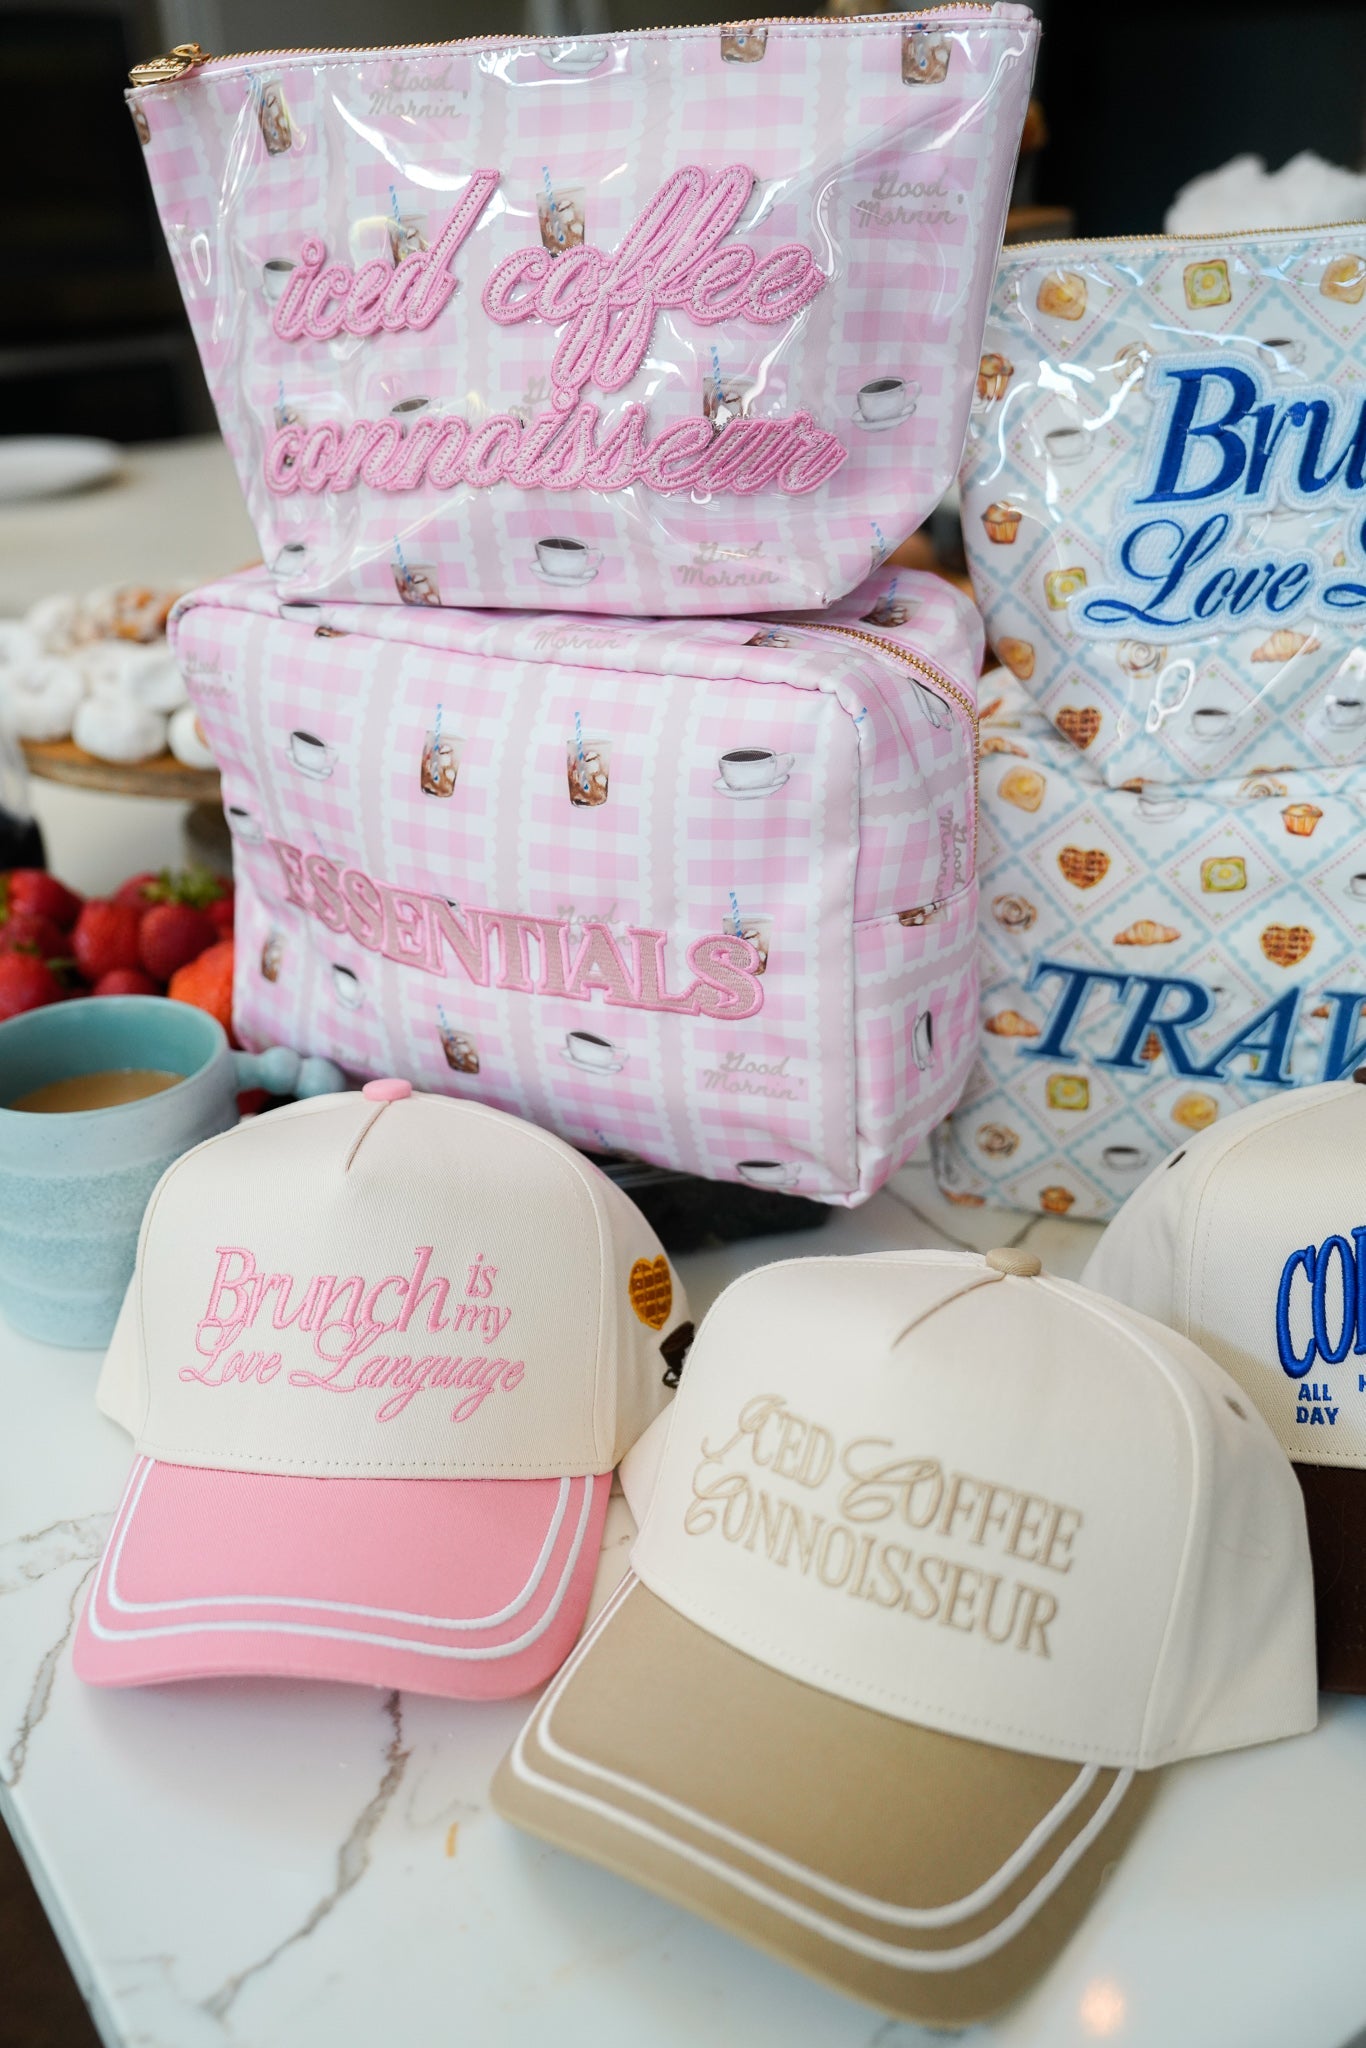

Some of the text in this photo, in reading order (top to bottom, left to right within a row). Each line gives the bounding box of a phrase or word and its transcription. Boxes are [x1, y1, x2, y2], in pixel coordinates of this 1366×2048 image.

[872, 166, 948, 200] Good
[272, 163, 830, 392] iced coffee
[263, 385, 849, 496] connoisseur
[1083, 512, 1311, 627] Love
[266, 833, 764, 1021] ESSENTIALS
[720, 1051, 790, 1078] Good
[198, 1246, 512, 1344] Brunch is my
[178, 1319, 525, 1423] Love Language
[1296, 1405, 1339, 1425] DAY
[1298, 1383, 1332, 1402] ALL
[700, 1393, 1084, 1574] ICED COFFEE
[683, 1456, 1059, 1660] CONNOISSEUR
